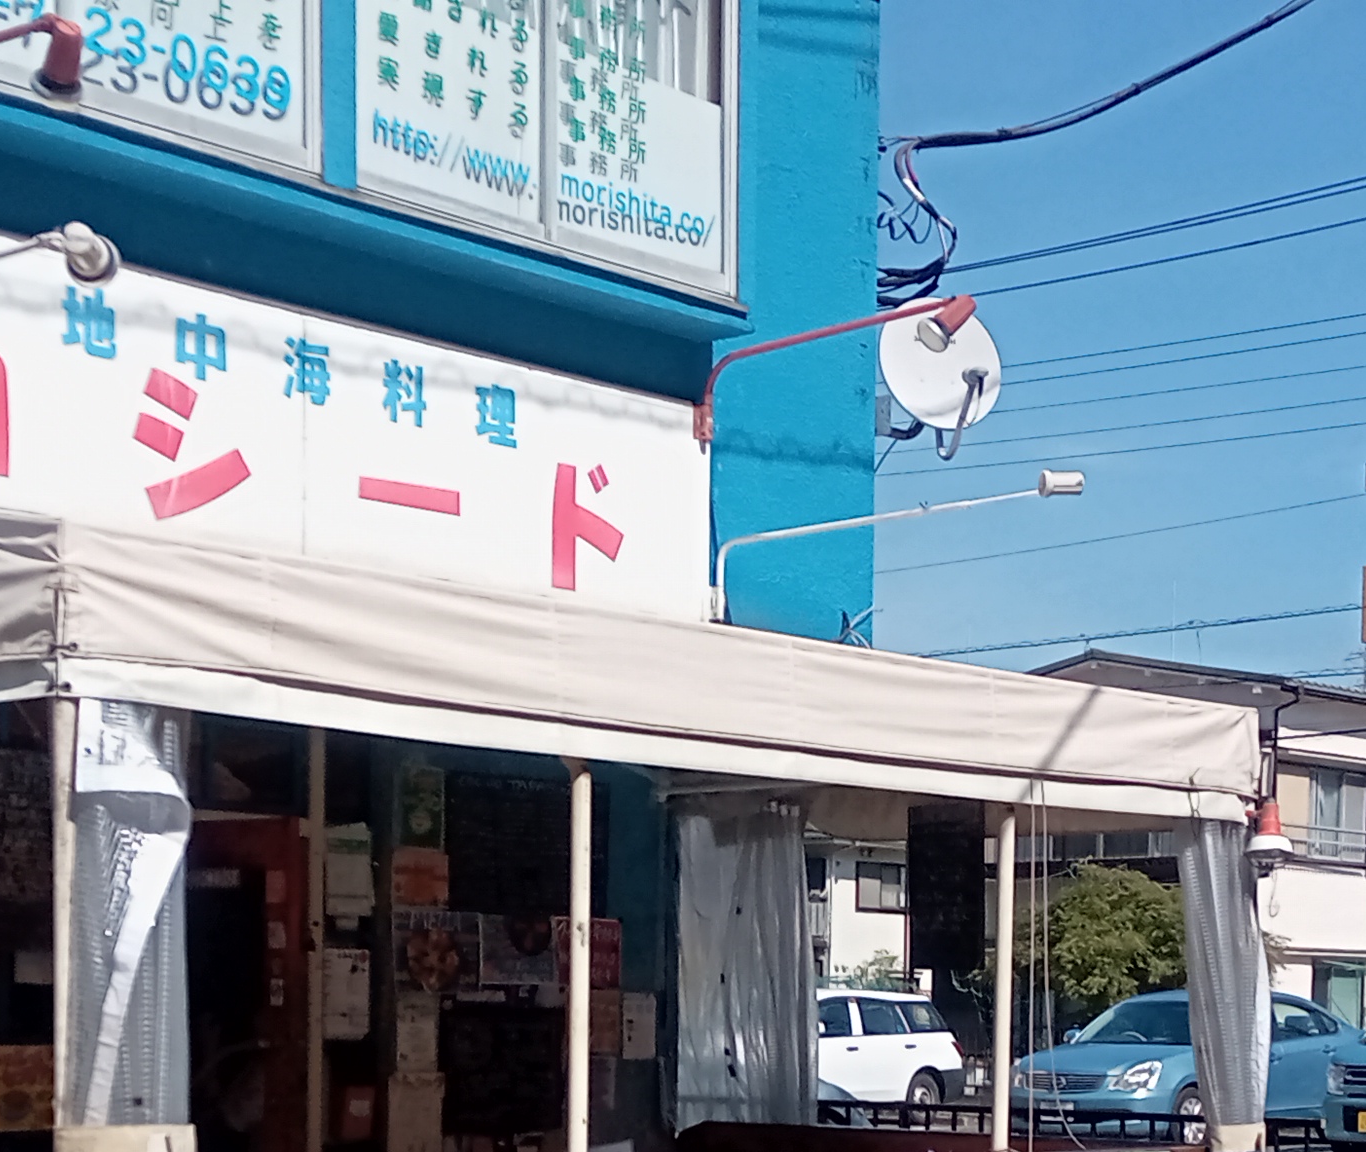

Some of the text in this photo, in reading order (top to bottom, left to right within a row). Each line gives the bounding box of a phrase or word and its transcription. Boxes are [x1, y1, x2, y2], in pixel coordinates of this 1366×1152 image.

[62, 286, 519, 448] 地中海料理
